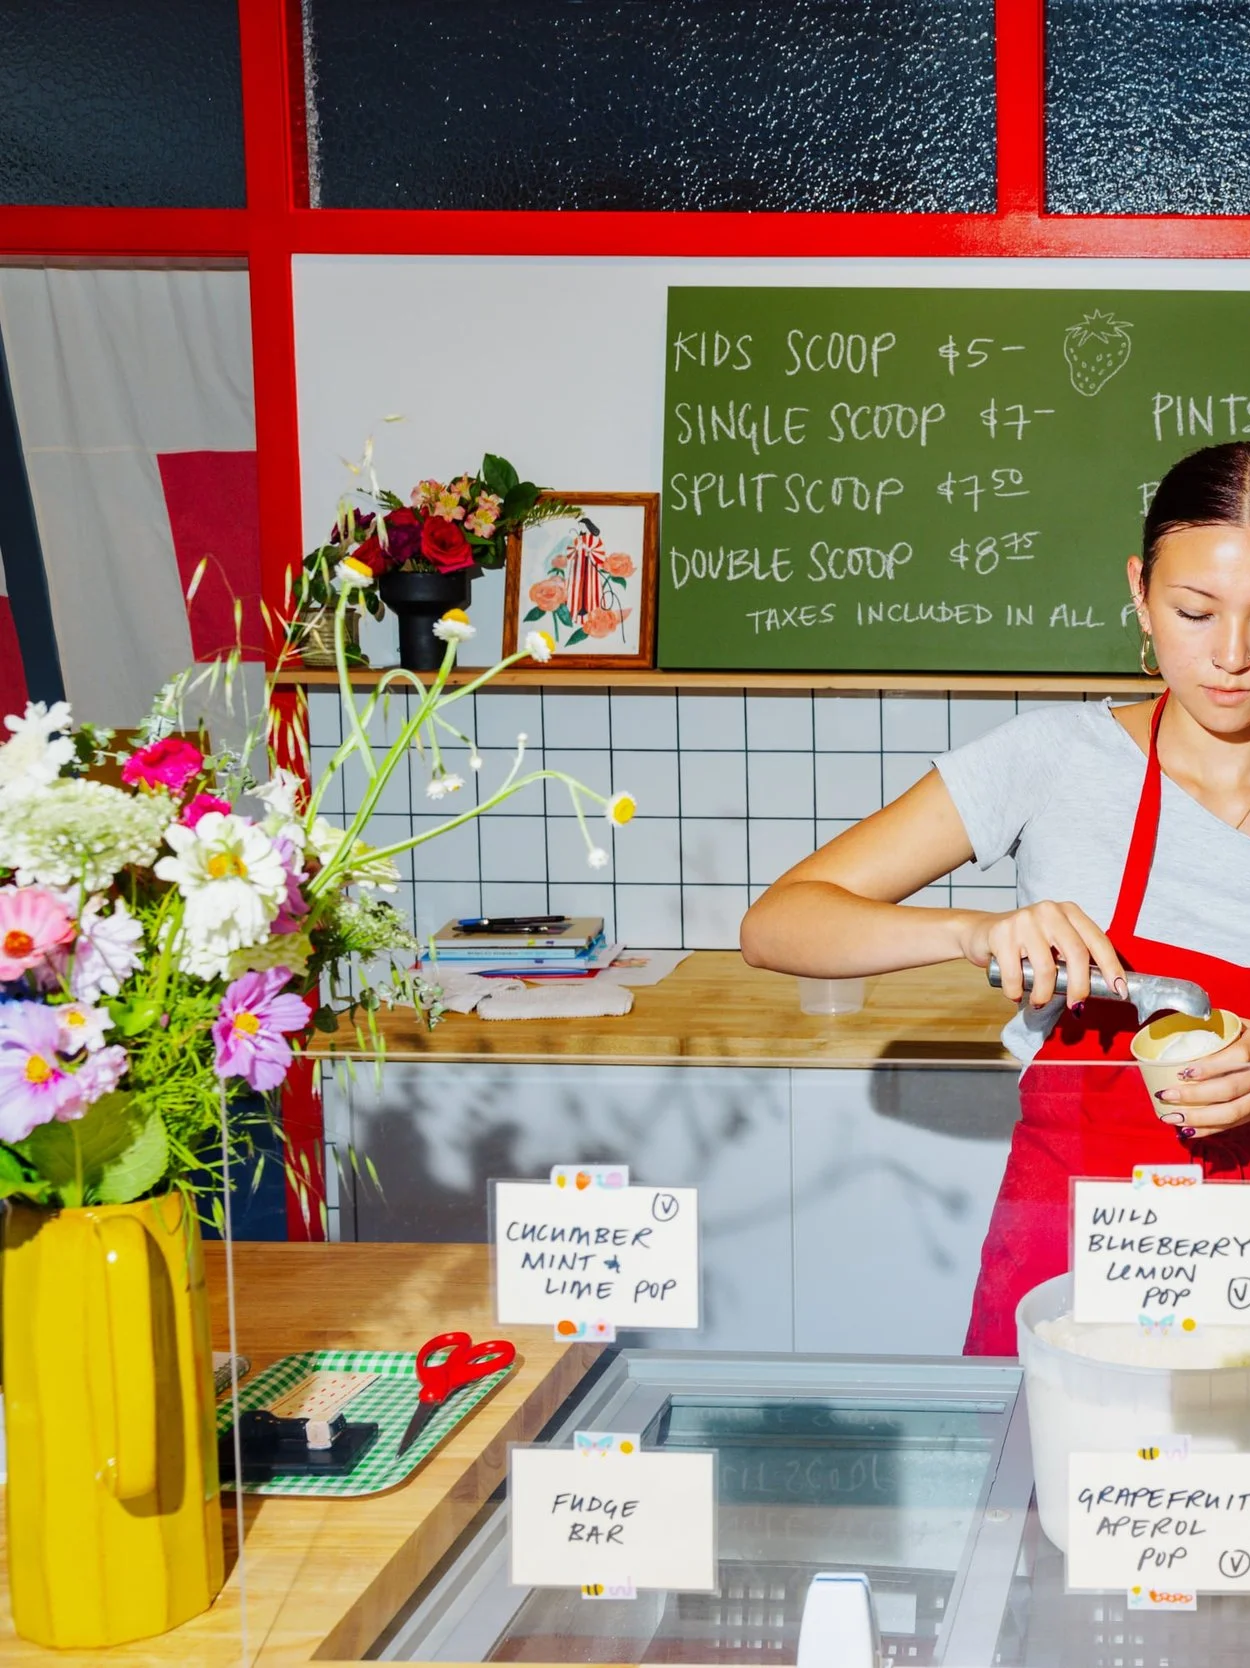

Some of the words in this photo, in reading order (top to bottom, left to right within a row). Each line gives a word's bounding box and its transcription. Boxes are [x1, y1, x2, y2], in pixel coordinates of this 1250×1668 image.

[673, 330, 752, 372] KIDS
[785, 329, 896, 377] SCOOP
[675, 400, 809, 455] SINGLE
[828, 402, 945, 446] SCOOP
[671, 472, 777, 516] SPLIT
[785, 473, 904, 515] SCOOP
[670, 546, 793, 590] DOUBLE
[808, 541, 913, 581] SCOOP
[746, 603, 836, 634] TAXES
[857, 601, 992, 626] INCLUDED
[1007, 605, 1033, 625] IN
[1050, 604, 1105, 628] ALL
[1093, 1208, 1157, 1225] WILD
[507, 1221, 656, 1248] CUCUMBER
[521, 1252, 596, 1271] MINT
[545, 1278, 613, 1299] LIME
[634, 1279, 676, 1303] POP
[1142, 1287, 1191, 1308] POP
[552, 1493, 638, 1519] FUDGE
[568, 1523, 623, 1544] BAR
[1096, 1516, 1205, 1538] APEROL
